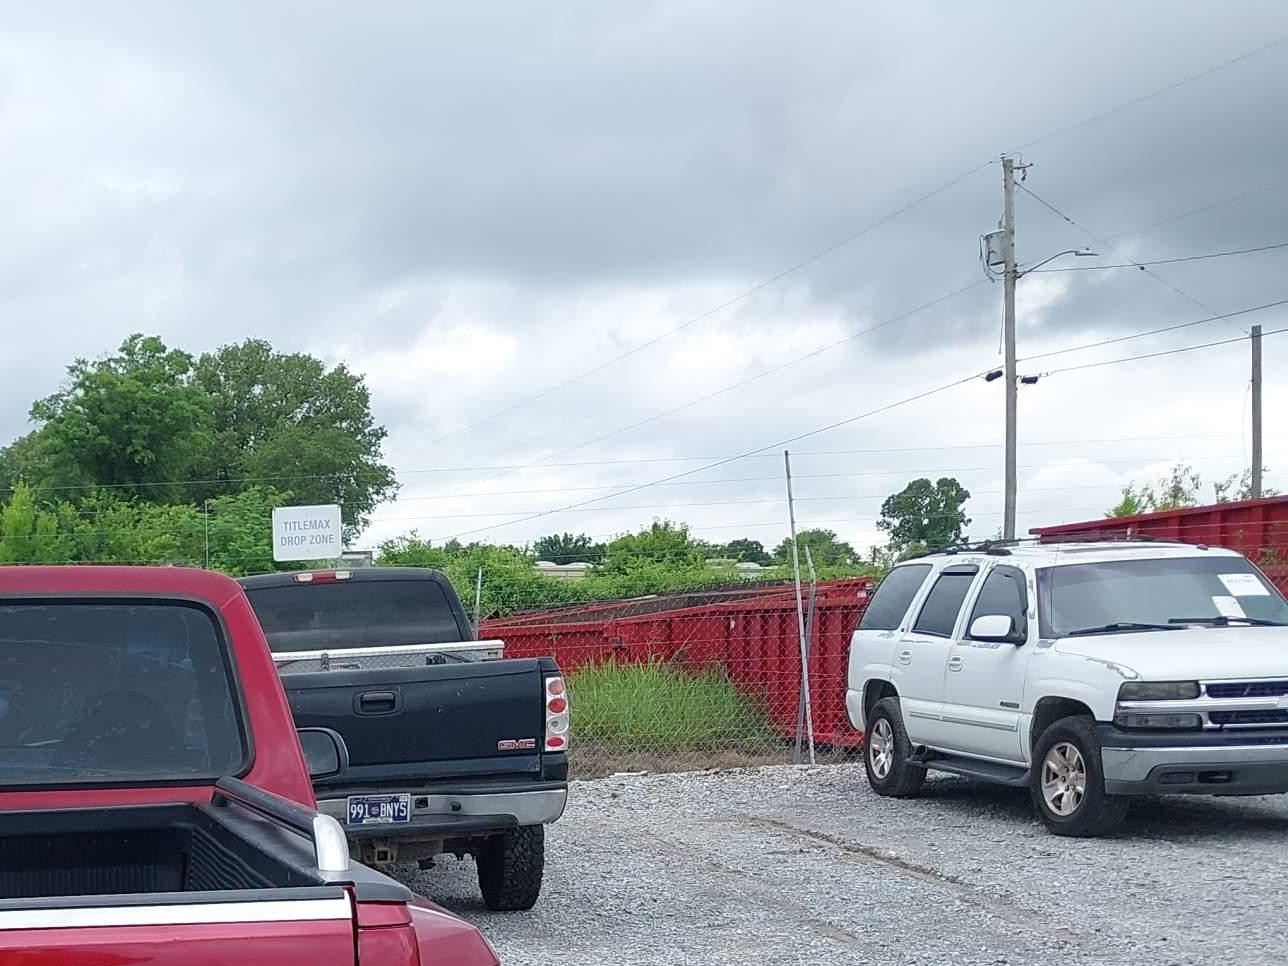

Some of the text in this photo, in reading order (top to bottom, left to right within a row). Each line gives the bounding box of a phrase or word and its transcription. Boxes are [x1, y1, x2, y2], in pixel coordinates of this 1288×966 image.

[283, 519, 330, 531] TITLEMAX
[280, 533, 335, 546] DROP ZONE
[498, 738, 536, 751] GMC
